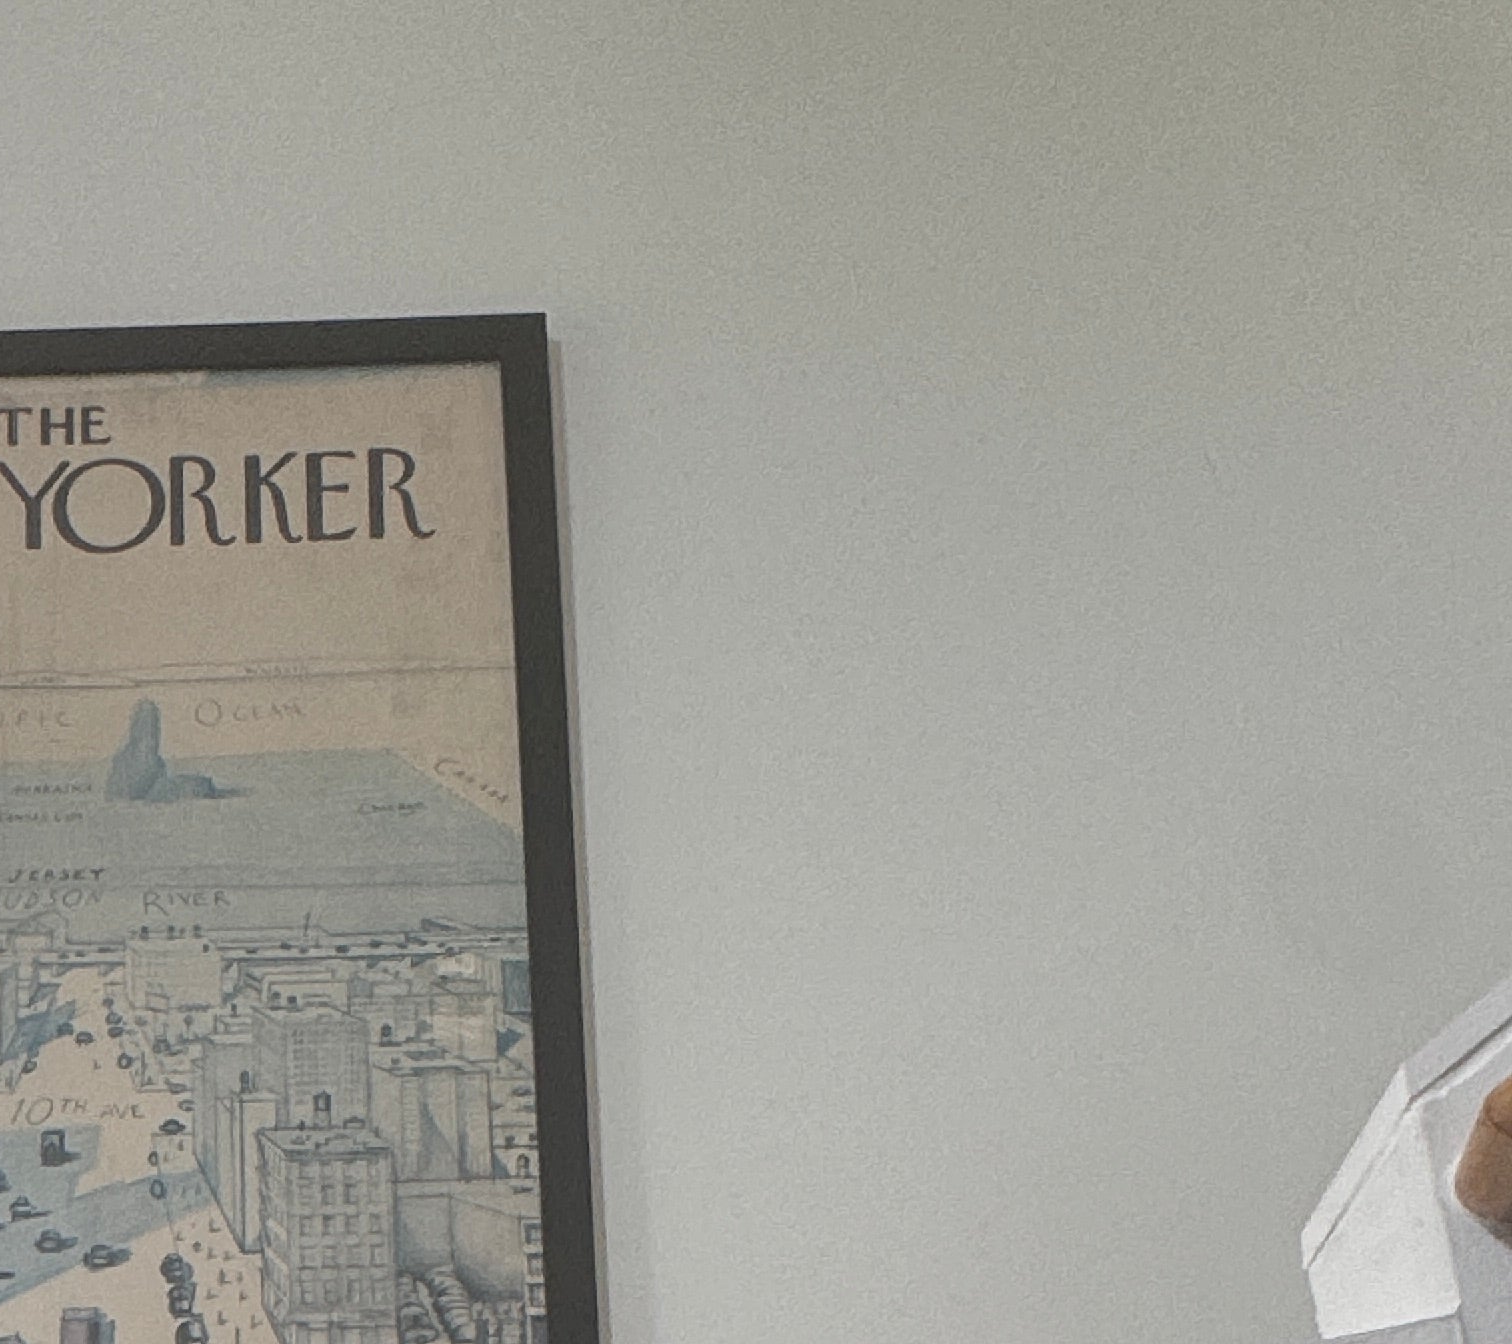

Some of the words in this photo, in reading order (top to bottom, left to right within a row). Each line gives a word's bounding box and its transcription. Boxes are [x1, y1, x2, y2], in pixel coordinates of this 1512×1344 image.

[194, 700, 306, 727] OCEAN
[142, 889, 231, 917] RIVER
[99, 1102, 146, 1120] AVE
